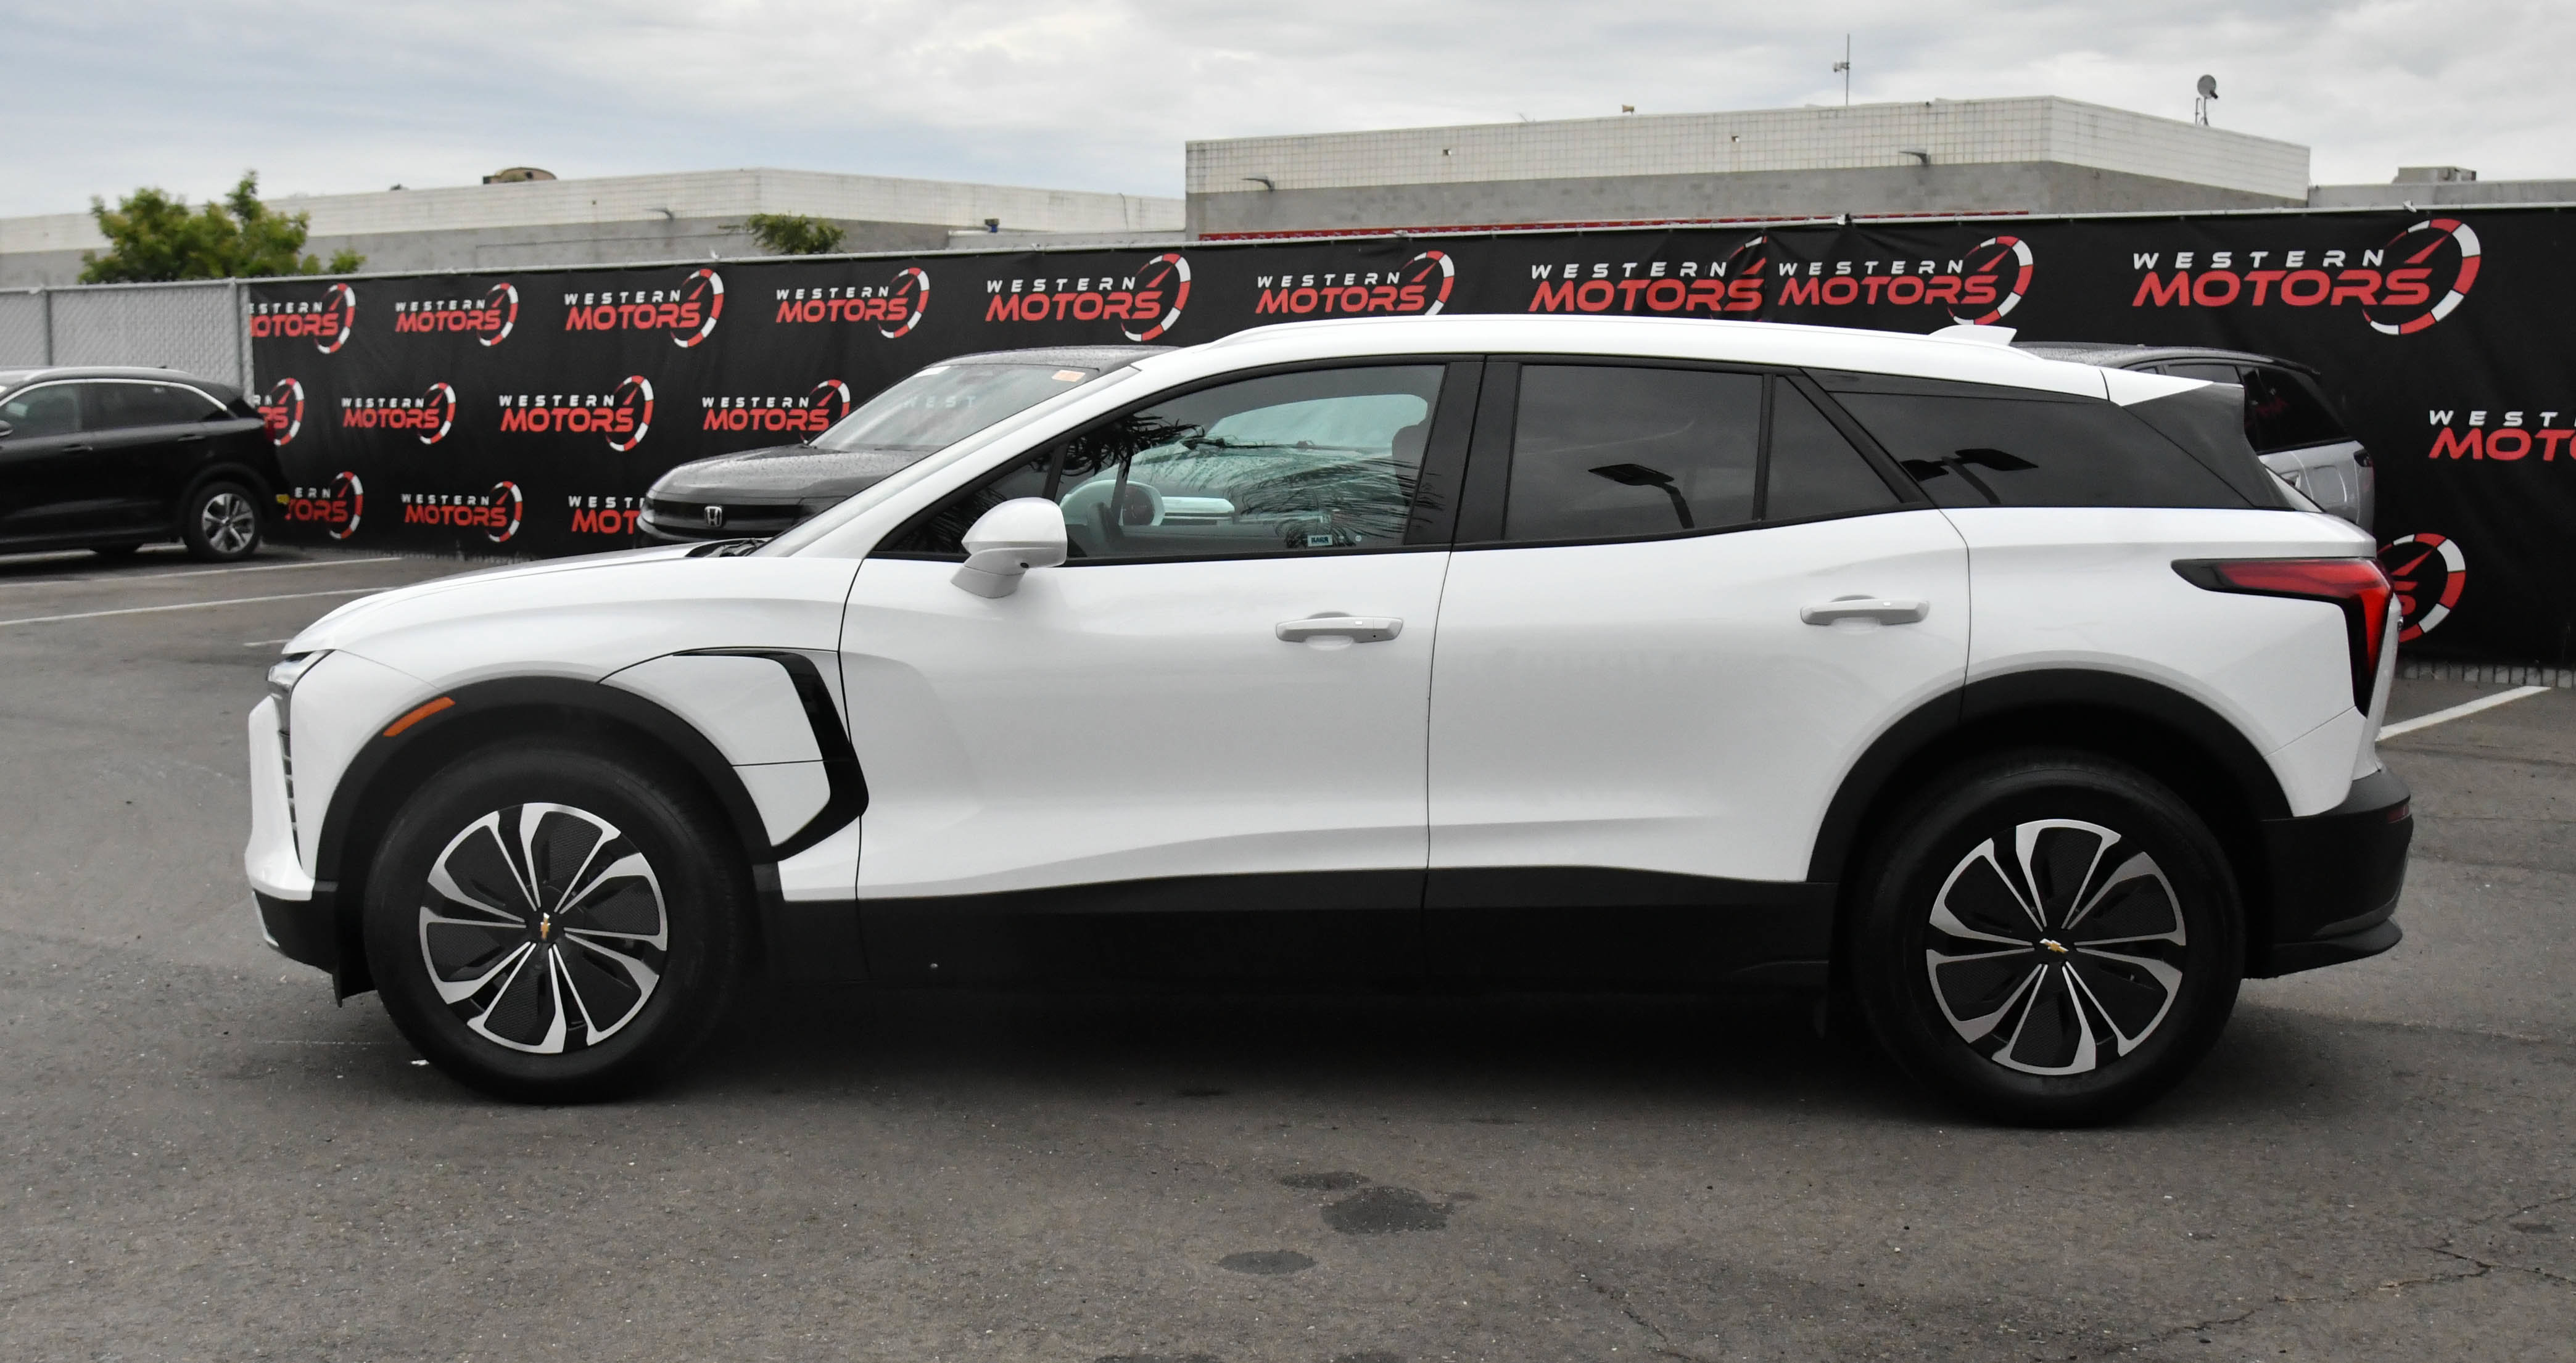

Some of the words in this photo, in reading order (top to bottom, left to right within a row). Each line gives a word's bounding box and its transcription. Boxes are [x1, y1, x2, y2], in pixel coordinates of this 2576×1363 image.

[1532, 261, 1727, 279] WESTERN
[1779, 259, 1963, 276] WESTERN
[2133, 249, 2384, 270] WESTERN
[986, 276, 1136, 294] WESTERN
[1257, 271, 1400, 288] WESTERN
[1778, 274, 1999, 306] MOTORS
[2132, 268, 2433, 307] MOTORS
[564, 289, 681, 305] WESTERN
[776, 286, 889, 300] WESTERN
[1255, 284, 1427, 314] MOTORS
[1529, 278, 1763, 313] MOTORS
[395, 299, 485, 312] WESTERN
[565, 302, 701, 331] MOTORS
[775, 297, 909, 323] MOTORS
[985, 290, 1163, 321] MOTORS
[395, 309, 502, 332] MOTORS
[341, 397, 424, 408] WESTERN
[498, 394, 614, 407] WESTERN
[701, 397, 809, 408] WESTERN
[343, 406, 440, 429] MOTORS
[500, 406, 635, 433] MOTORS
[703, 408, 830, 432] MOTORS
[2429, 410, 2576, 427] WEST
[2429, 426, 2576, 461] MOT
[402, 494, 489, 505] WESTERN
[404, 503, 508, 527] MOTORS
